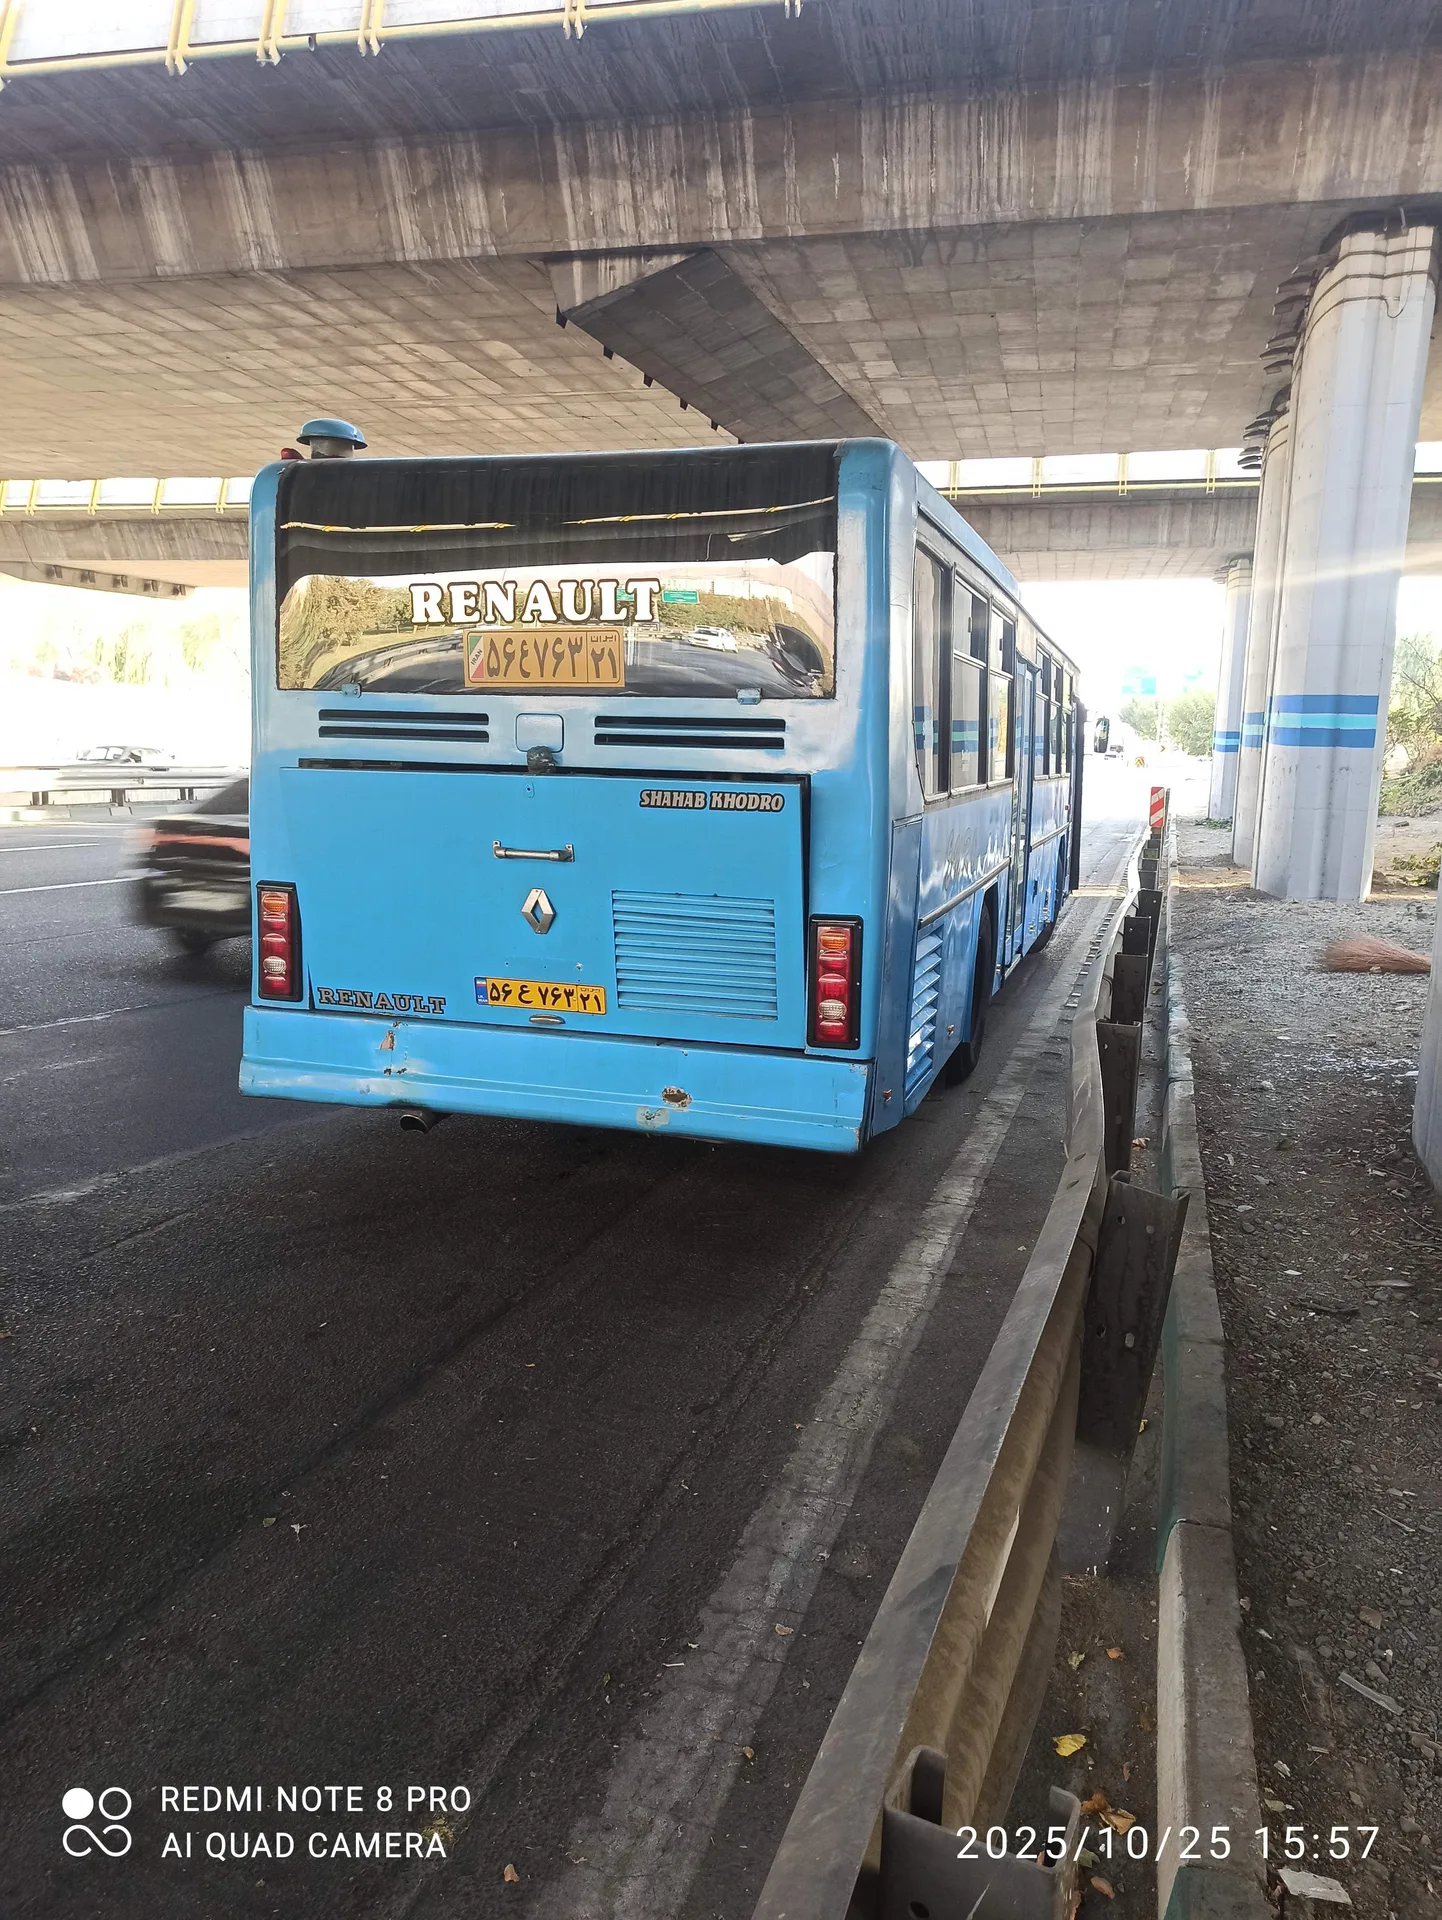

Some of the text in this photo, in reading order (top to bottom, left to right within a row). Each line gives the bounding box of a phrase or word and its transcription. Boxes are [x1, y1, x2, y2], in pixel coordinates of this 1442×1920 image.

[409, 578, 660, 626] RENAULT
[470, 648, 483, 666] IRAN
[590, 646, 618, 679] ۲۱
[639, 789, 785, 812] SHAHAB KHODRO
[317, 987, 446, 1014] RENAULT
[580, 993, 601, 1012] ۲۱
